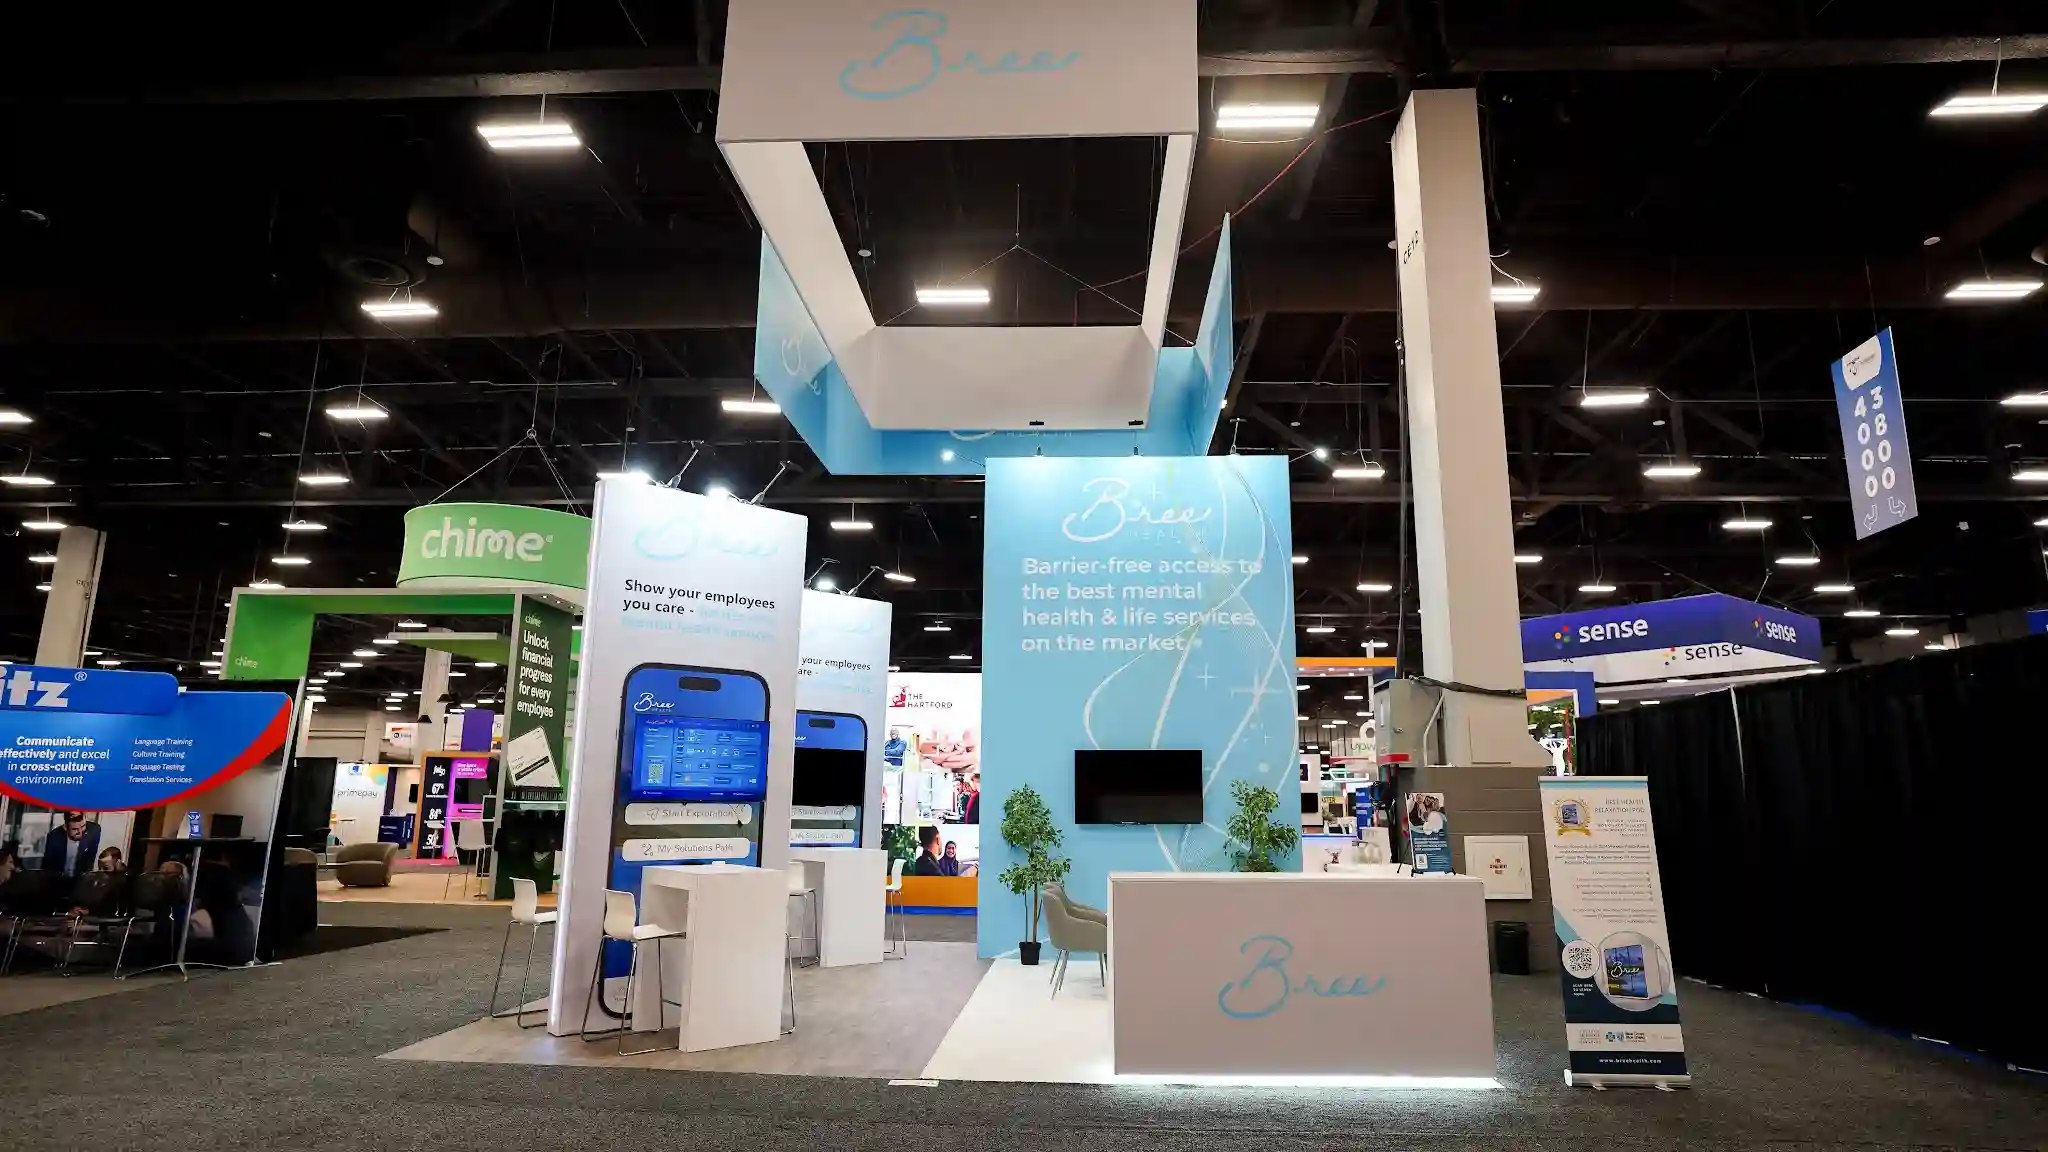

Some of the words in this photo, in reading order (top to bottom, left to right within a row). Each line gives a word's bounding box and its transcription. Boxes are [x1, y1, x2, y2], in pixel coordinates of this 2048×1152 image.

[840, 10, 1082, 99] Bree
[1062, 476, 1213, 543] Bree
[1022, 556, 1152, 575] Barrier-free
[1159, 558, 1234, 575] access
[1239, 559, 1262, 575] to
[624, 579, 666, 595] Show
[669, 587, 702, 600] your
[704, 592, 776, 609] employees
[1022, 583, 1061, 600] the
[1066, 582, 1115, 600] best
[1122, 582, 1202, 600] mental
[622, 599, 651, 612] you
[655, 603, 685, 615] care
[1022, 606, 1095, 626] health
[1101, 607, 1117, 626] &
[1123, 607, 1158, 626] life
[1163, 609, 1257, 627] services
[1578, 618, 1649, 643] sense
[1765, 620, 1797, 644] sense
[523, 629, 551, 651] Unlock
[1021, 635, 1051, 651] on
[1056, 634, 1095, 651] the
[521, 647, 554, 668] financial
[1684, 642, 1744, 661] sense
[801, 656, 823, 666] your
[824, 659, 872, 671] employees
[519, 665, 553, 684] progress
[518, 680, 530, 697] for
[530, 686, 552, 703] every
[516, 699, 554, 721] employee
[634, 692, 675, 711] Bree
[907, 701, 953, 709] HARTFORD
[16, 736, 95, 747] Communicate
[134, 737, 165, 747] Language
[166, 737, 193, 747] Training
[0, 748, 57, 760] effectively
[58, 749, 79, 759] and
[81, 749, 110, 759] excel
[132, 750, 157, 758] Culture
[158, 750, 186, 759] Training
[7, 761, 18, 771] in
[19, 761, 96, 772] cross-culture
[130, 763, 161, 771] Language
[15, 774, 84, 784] environment
[129, 775, 164, 783] Translation
[337, 787, 379, 799] primepay
[662, 808, 684, 817] Start
[657, 844, 672, 854] My
[674, 843, 713, 853] Solutions
[715, 843, 734, 852] Path
[1218, 935, 1386, 1019] Bree
